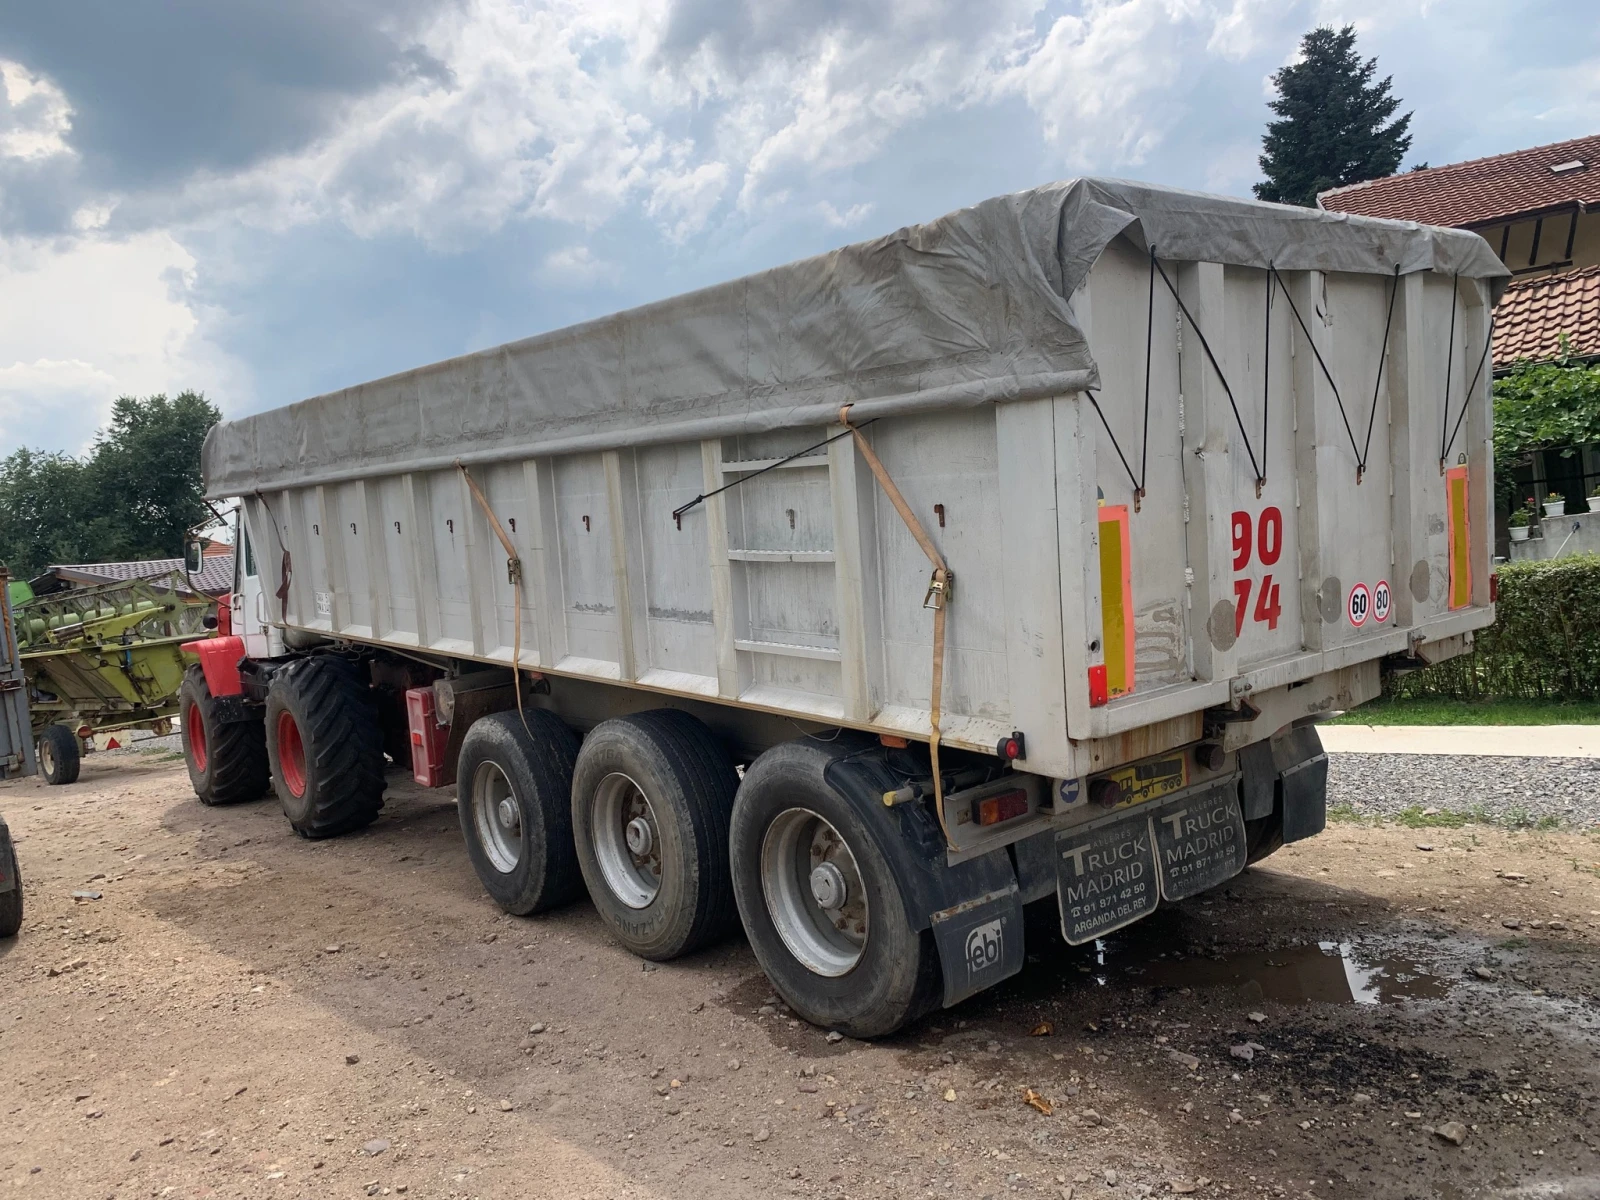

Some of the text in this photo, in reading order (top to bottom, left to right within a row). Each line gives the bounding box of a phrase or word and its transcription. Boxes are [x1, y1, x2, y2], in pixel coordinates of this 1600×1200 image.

[1231, 506, 1283, 572] 90
[1234, 574, 1282, 638] 74
[1352, 593, 1367, 615] 60
[1376, 589, 1388, 610] 80
[1161, 802, 1237, 840] TRUCK
[1062, 837, 1147, 877] TRUCK
[1166, 825, 1235, 865] MADRID
[1181, 863, 1193, 875] 91
[1196, 855, 1212, 869] 871
[1225, 844, 1236, 856] 50
[1067, 861, 1144, 904] MADRID
[1083, 882, 1145, 914] 91 871 42 50
[1074, 896, 1147, 935] ARGANDA DEL REY
[964, 926, 1003, 970] febi
